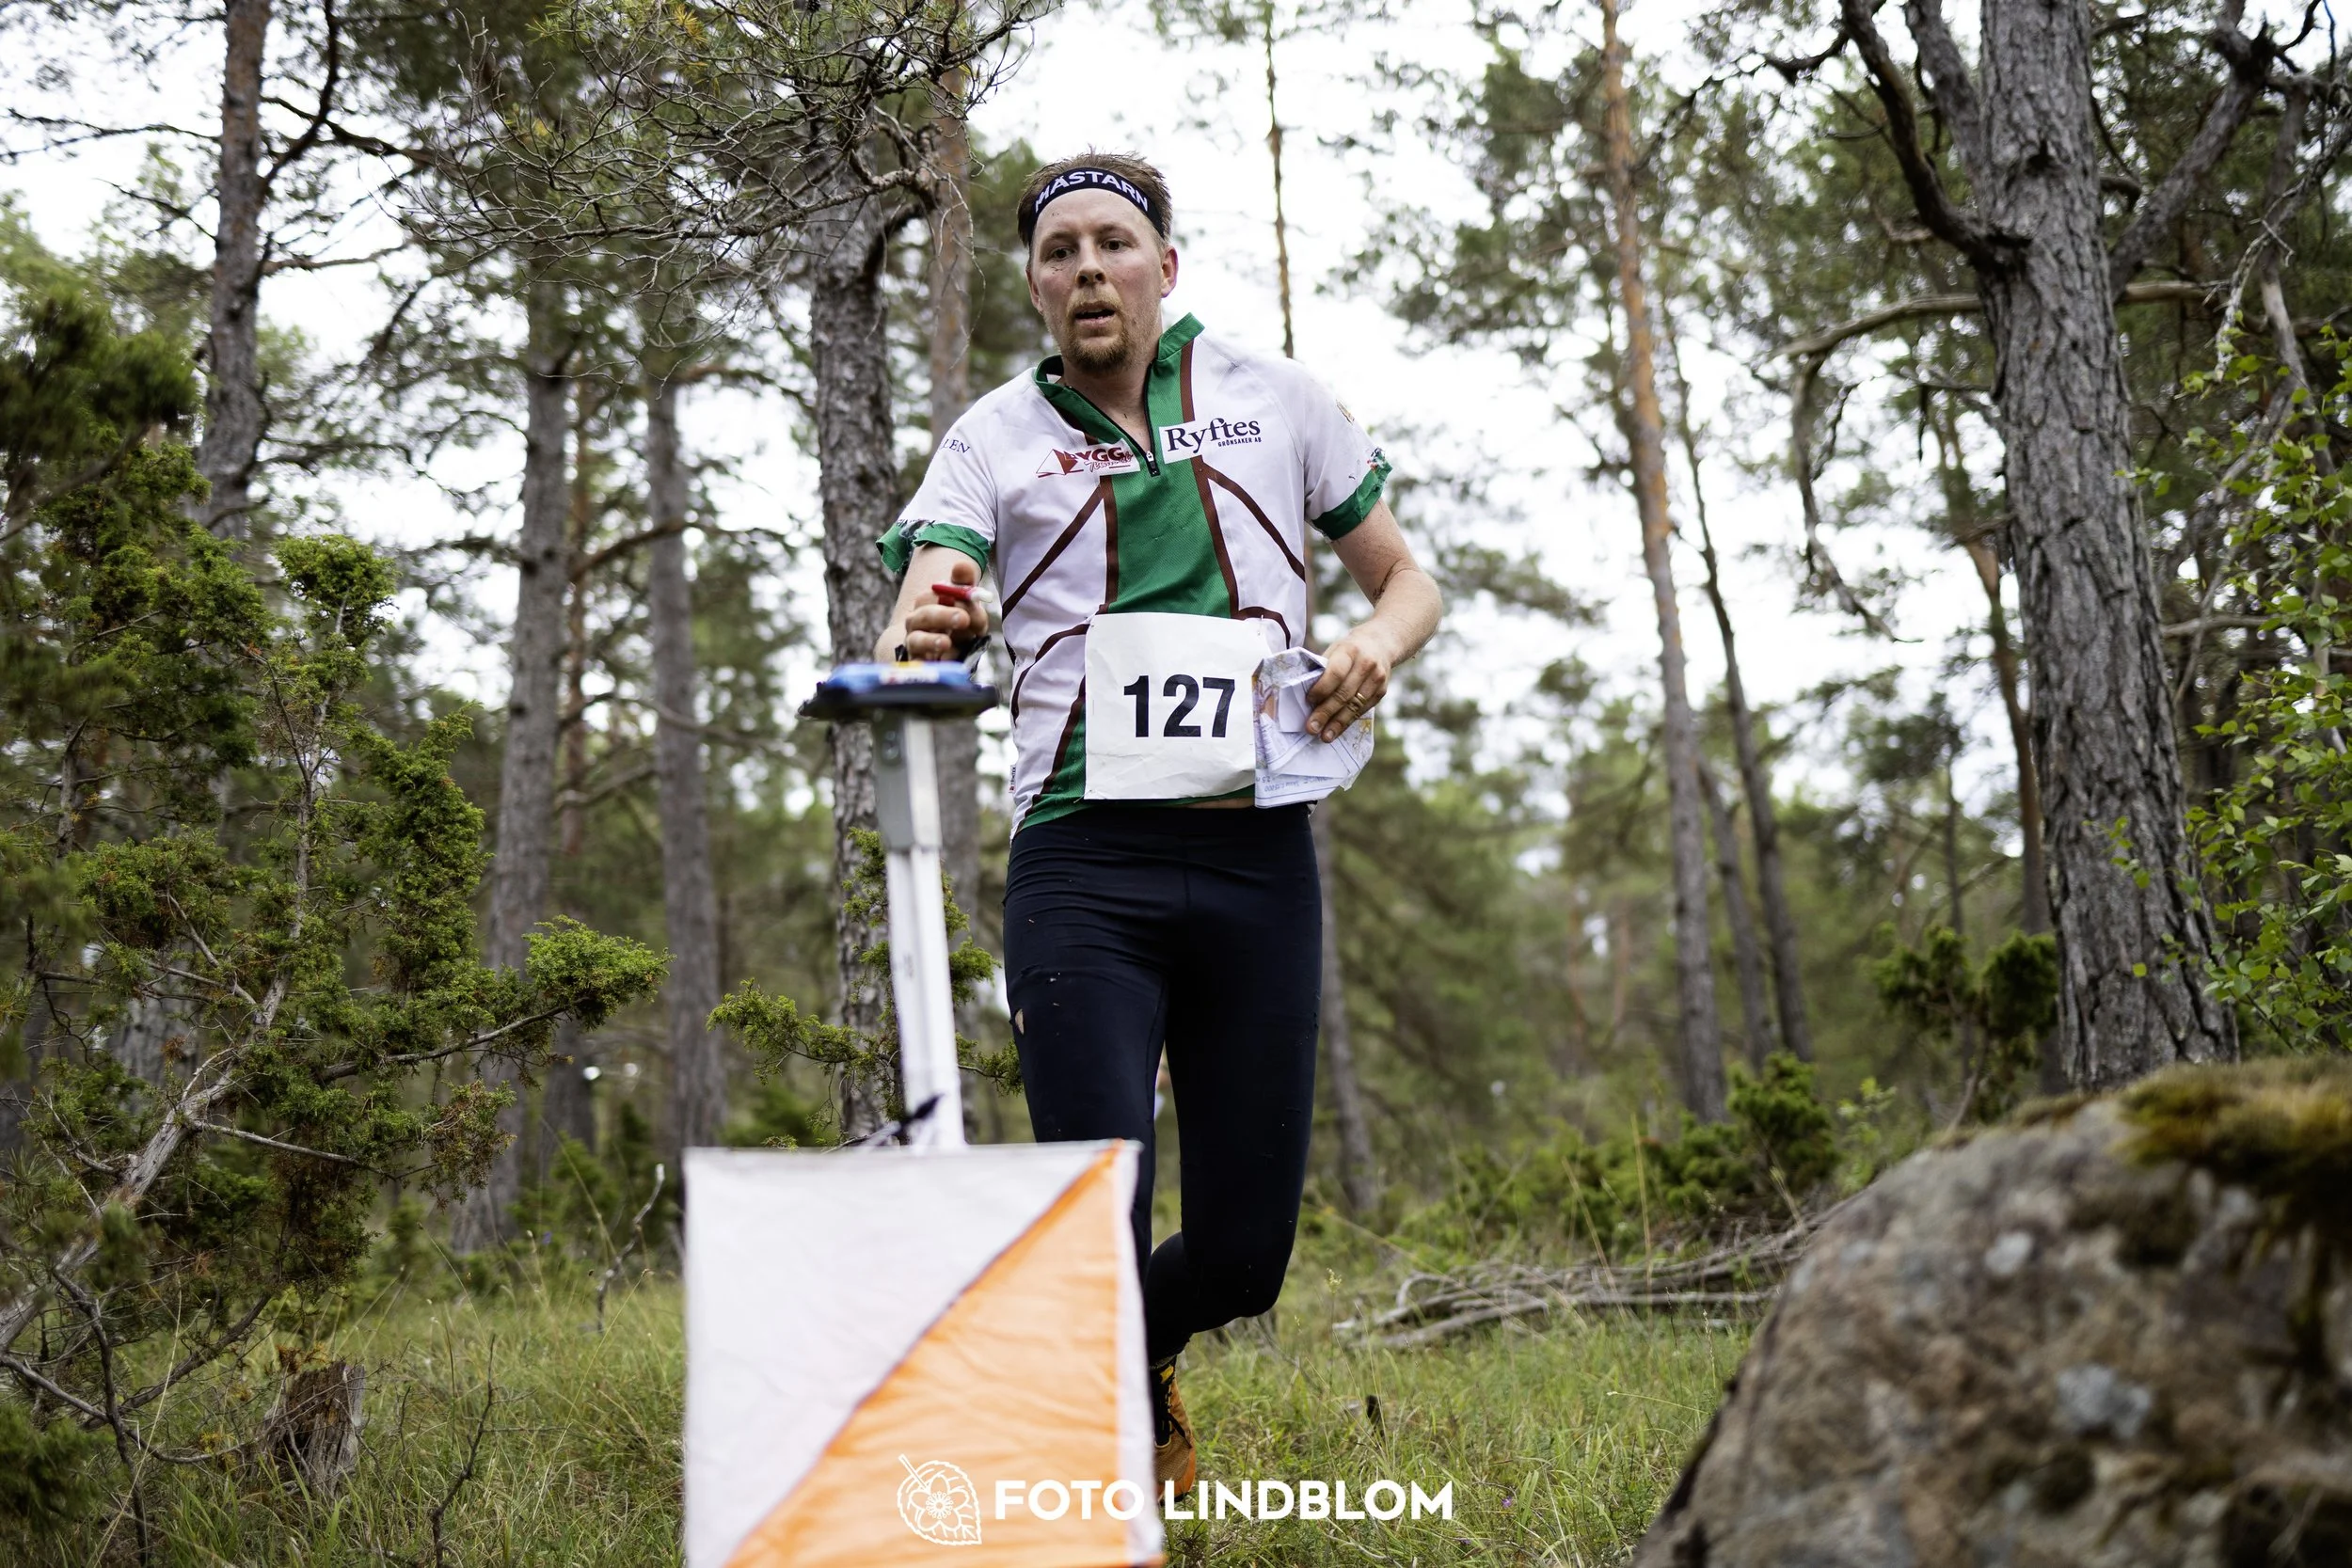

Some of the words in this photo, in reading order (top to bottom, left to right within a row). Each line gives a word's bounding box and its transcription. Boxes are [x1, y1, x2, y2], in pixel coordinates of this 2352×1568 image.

[1035, 170, 1149, 213] MÄSTARN
[1165, 418, 1261, 453] Ryftes
[1123, 673, 1235, 737] 127
